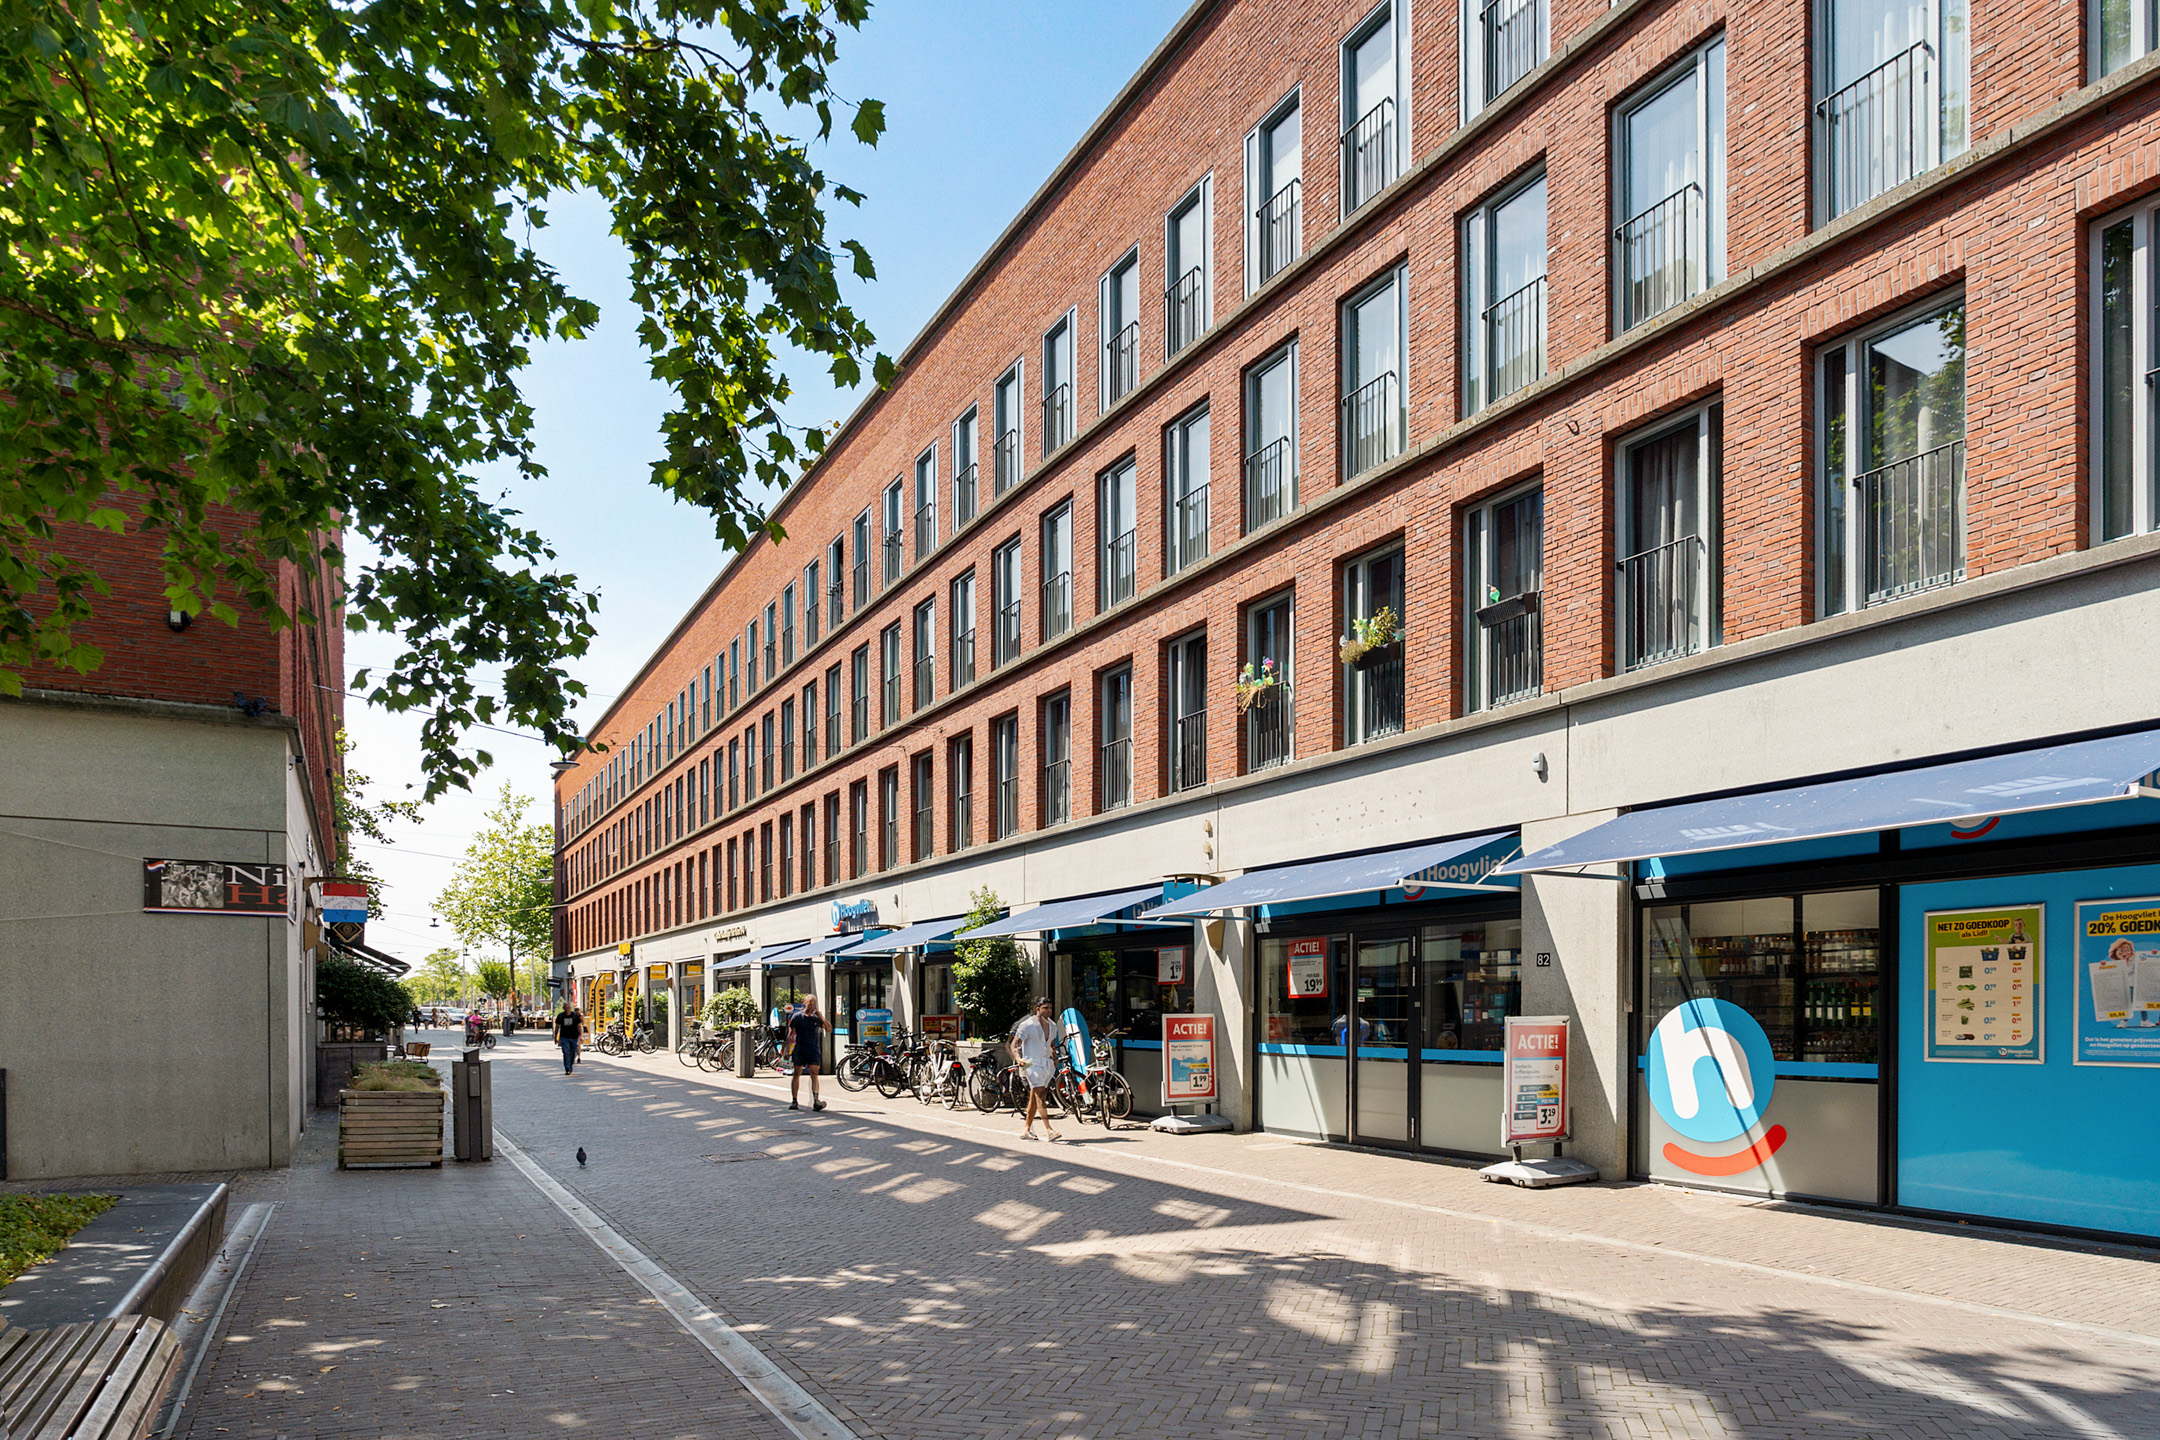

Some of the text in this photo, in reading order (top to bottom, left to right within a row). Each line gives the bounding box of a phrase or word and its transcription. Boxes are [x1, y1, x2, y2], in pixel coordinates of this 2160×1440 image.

[2102, 910, 2157, 922] De Hoogvliet
[1937, 919, 2010, 932] NET ZO GOEDKOOP
[2088, 921, 2117, 935] 20%
[1972, 929, 1988, 937] Lidl!
[1293, 941, 1320, 954] ACTIE!
[1537, 954, 1550, 966] 82
[1172, 1023, 1207, 1035] ACTIE!
[1517, 1034, 1559, 1050] ACTIE!
[1540, 1107, 1556, 1125] 3.19
